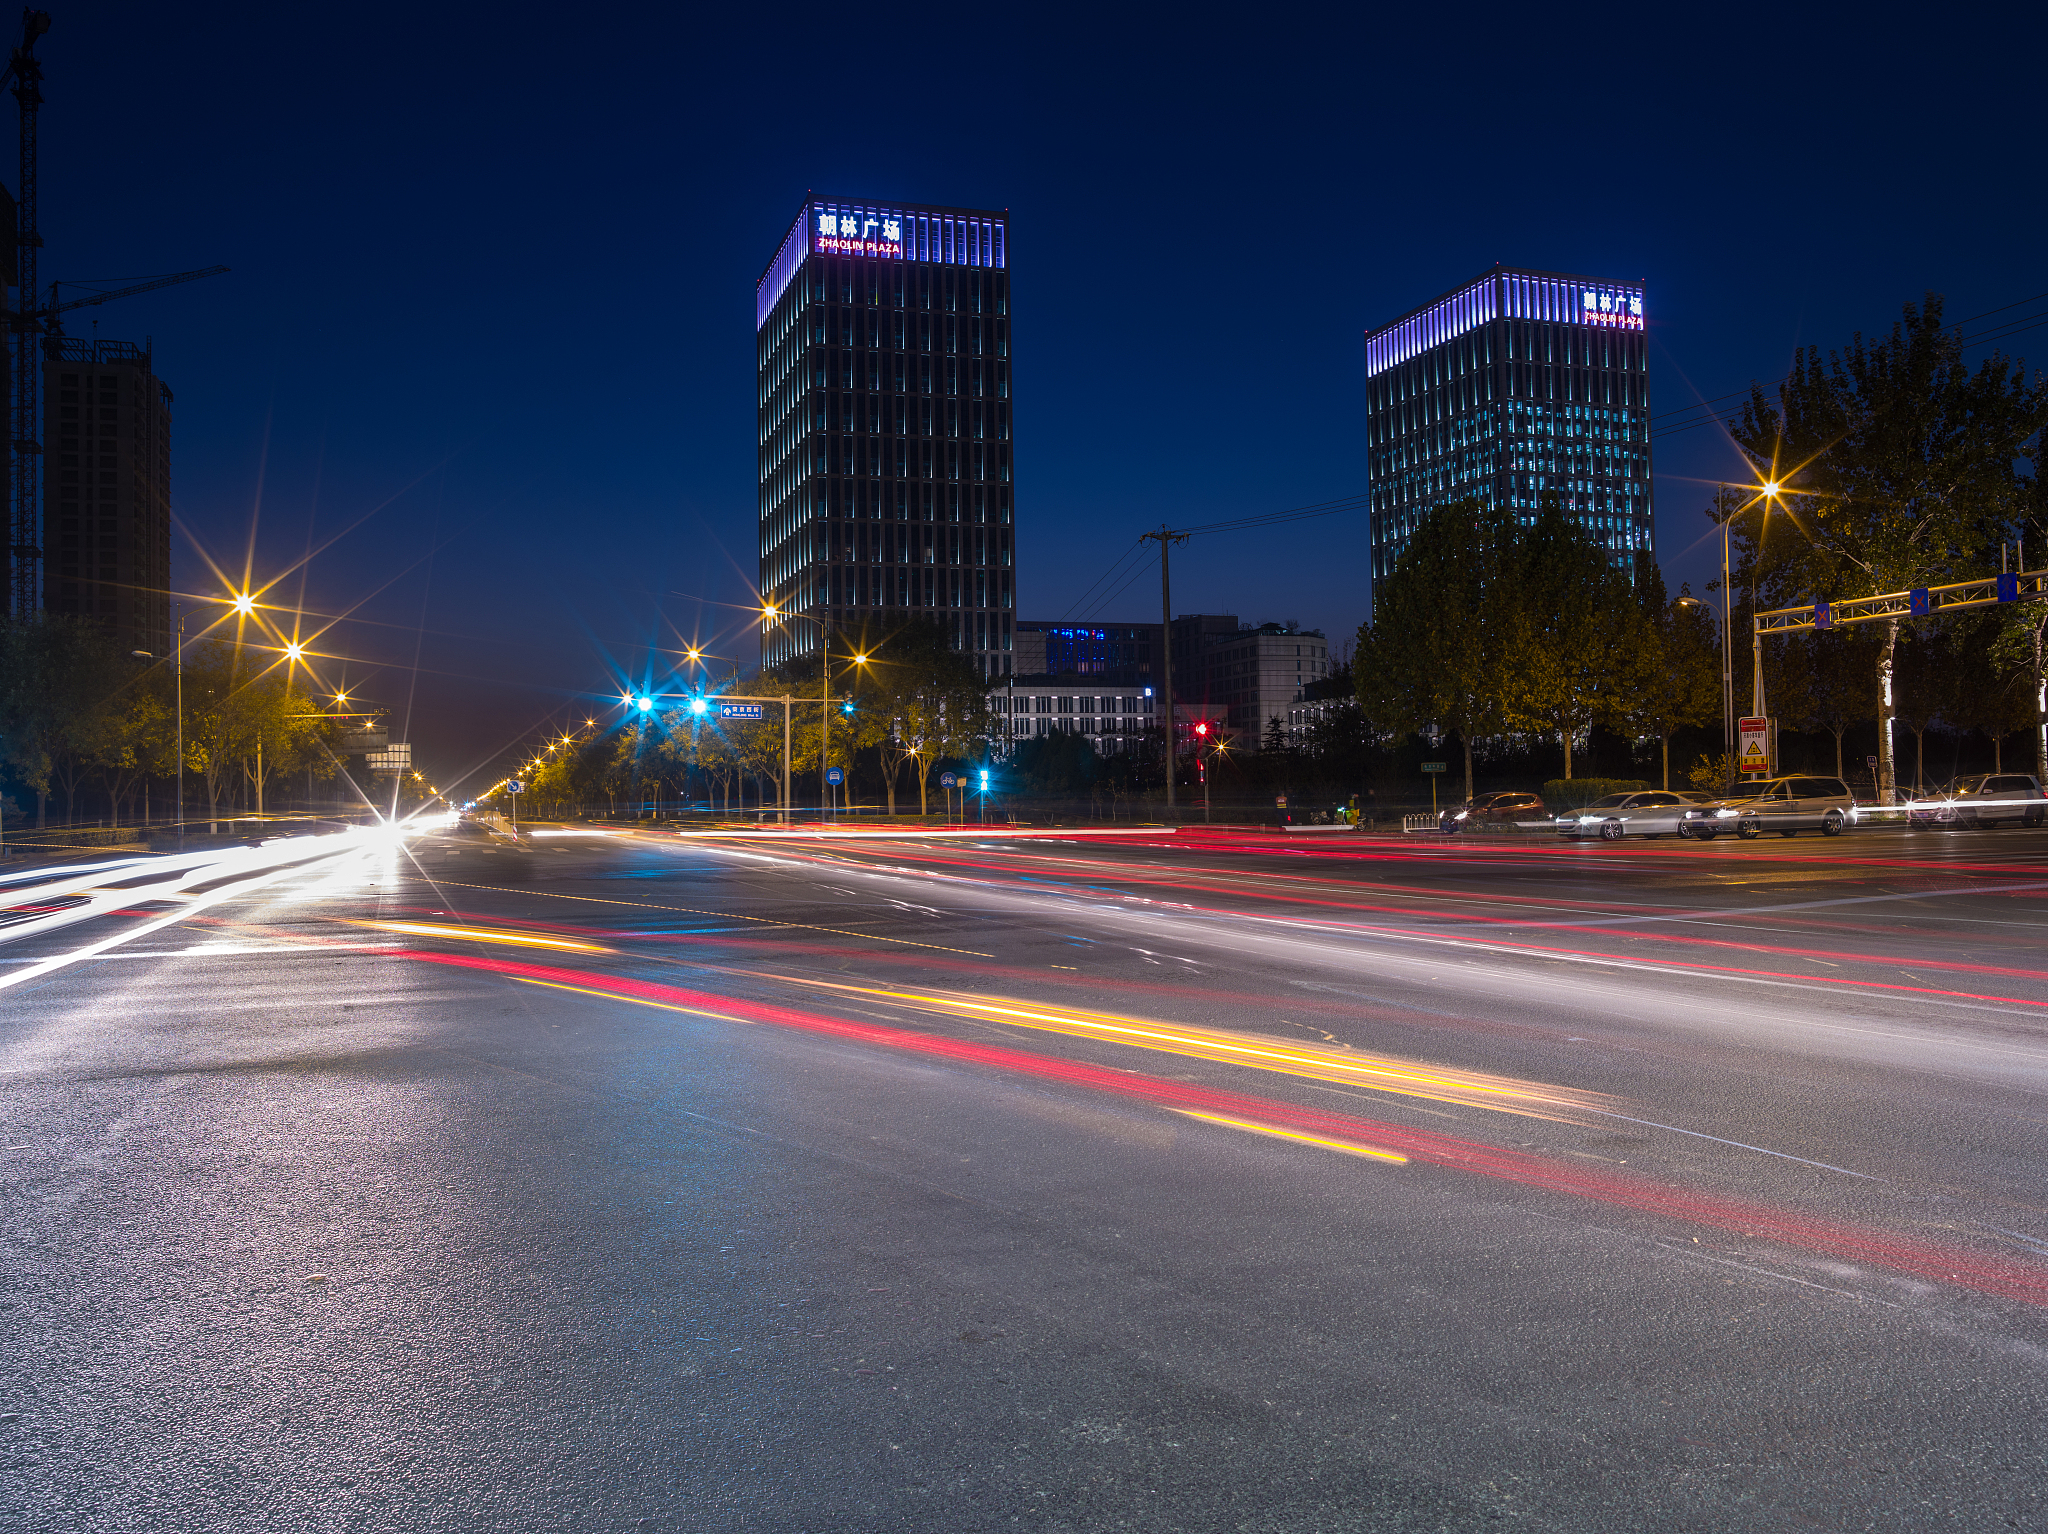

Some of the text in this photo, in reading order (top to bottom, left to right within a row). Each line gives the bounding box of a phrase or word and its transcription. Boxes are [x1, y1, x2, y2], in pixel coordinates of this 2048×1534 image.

[819, 214, 900, 241] 朝林广场
[819, 238, 900, 253] ZHAOLIN PLAZA
[1584, 291, 1642, 315] 朝林广场
[1585, 311, 1643, 325] ZHAOLIN PLAZA
